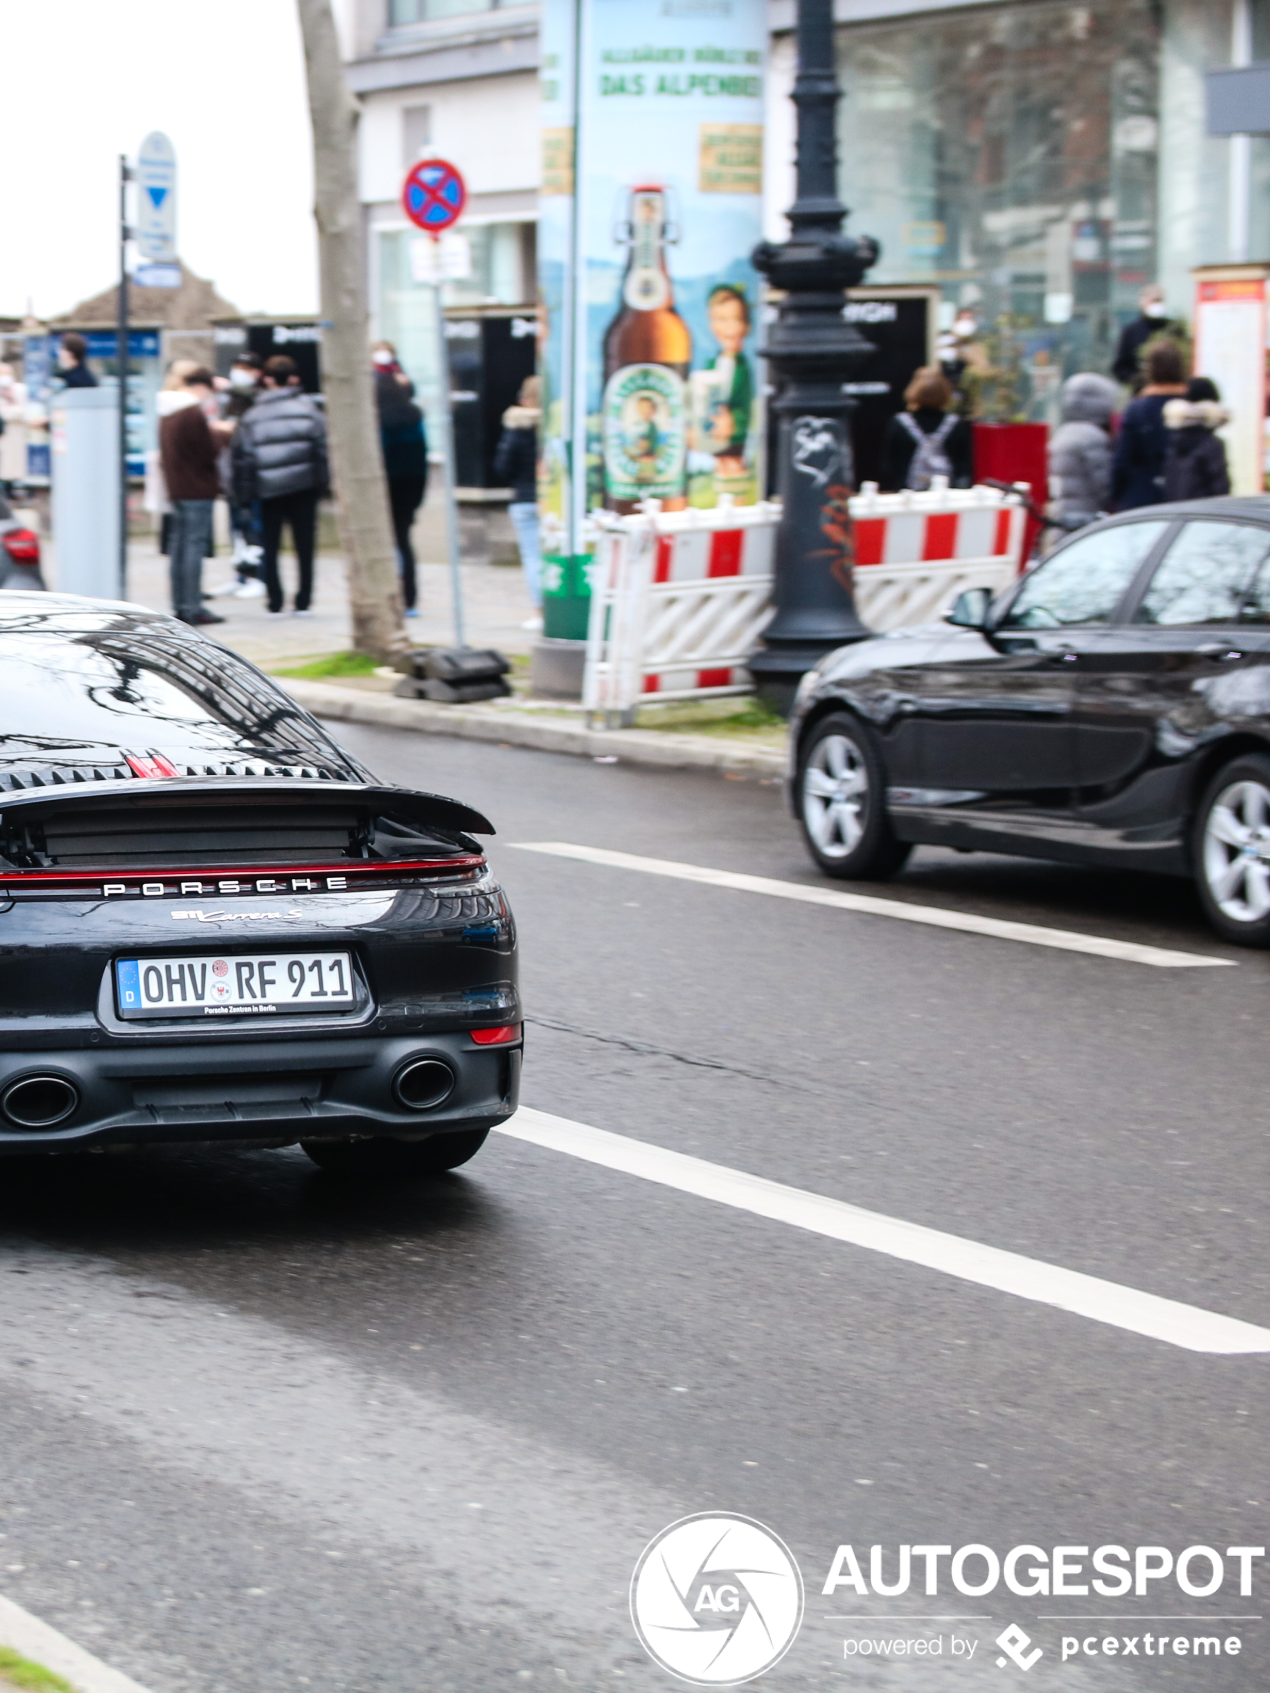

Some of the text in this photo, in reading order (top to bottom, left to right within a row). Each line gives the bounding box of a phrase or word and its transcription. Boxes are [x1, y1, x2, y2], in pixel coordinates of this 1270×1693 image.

[599, 74, 644, 96] DAS
[103, 877, 347, 897] PORSCHE
[199, 910, 282, 923] Carrera
[283, 909, 303, 920] S
[143, 958, 349, 1002] OHV RF 911
[125, 990, 135, 1003] D
[204, 1006, 228, 1014] Porsche
[229, 1005, 251, 1013] Zentren
[259, 1004, 276, 1012] Berlin
